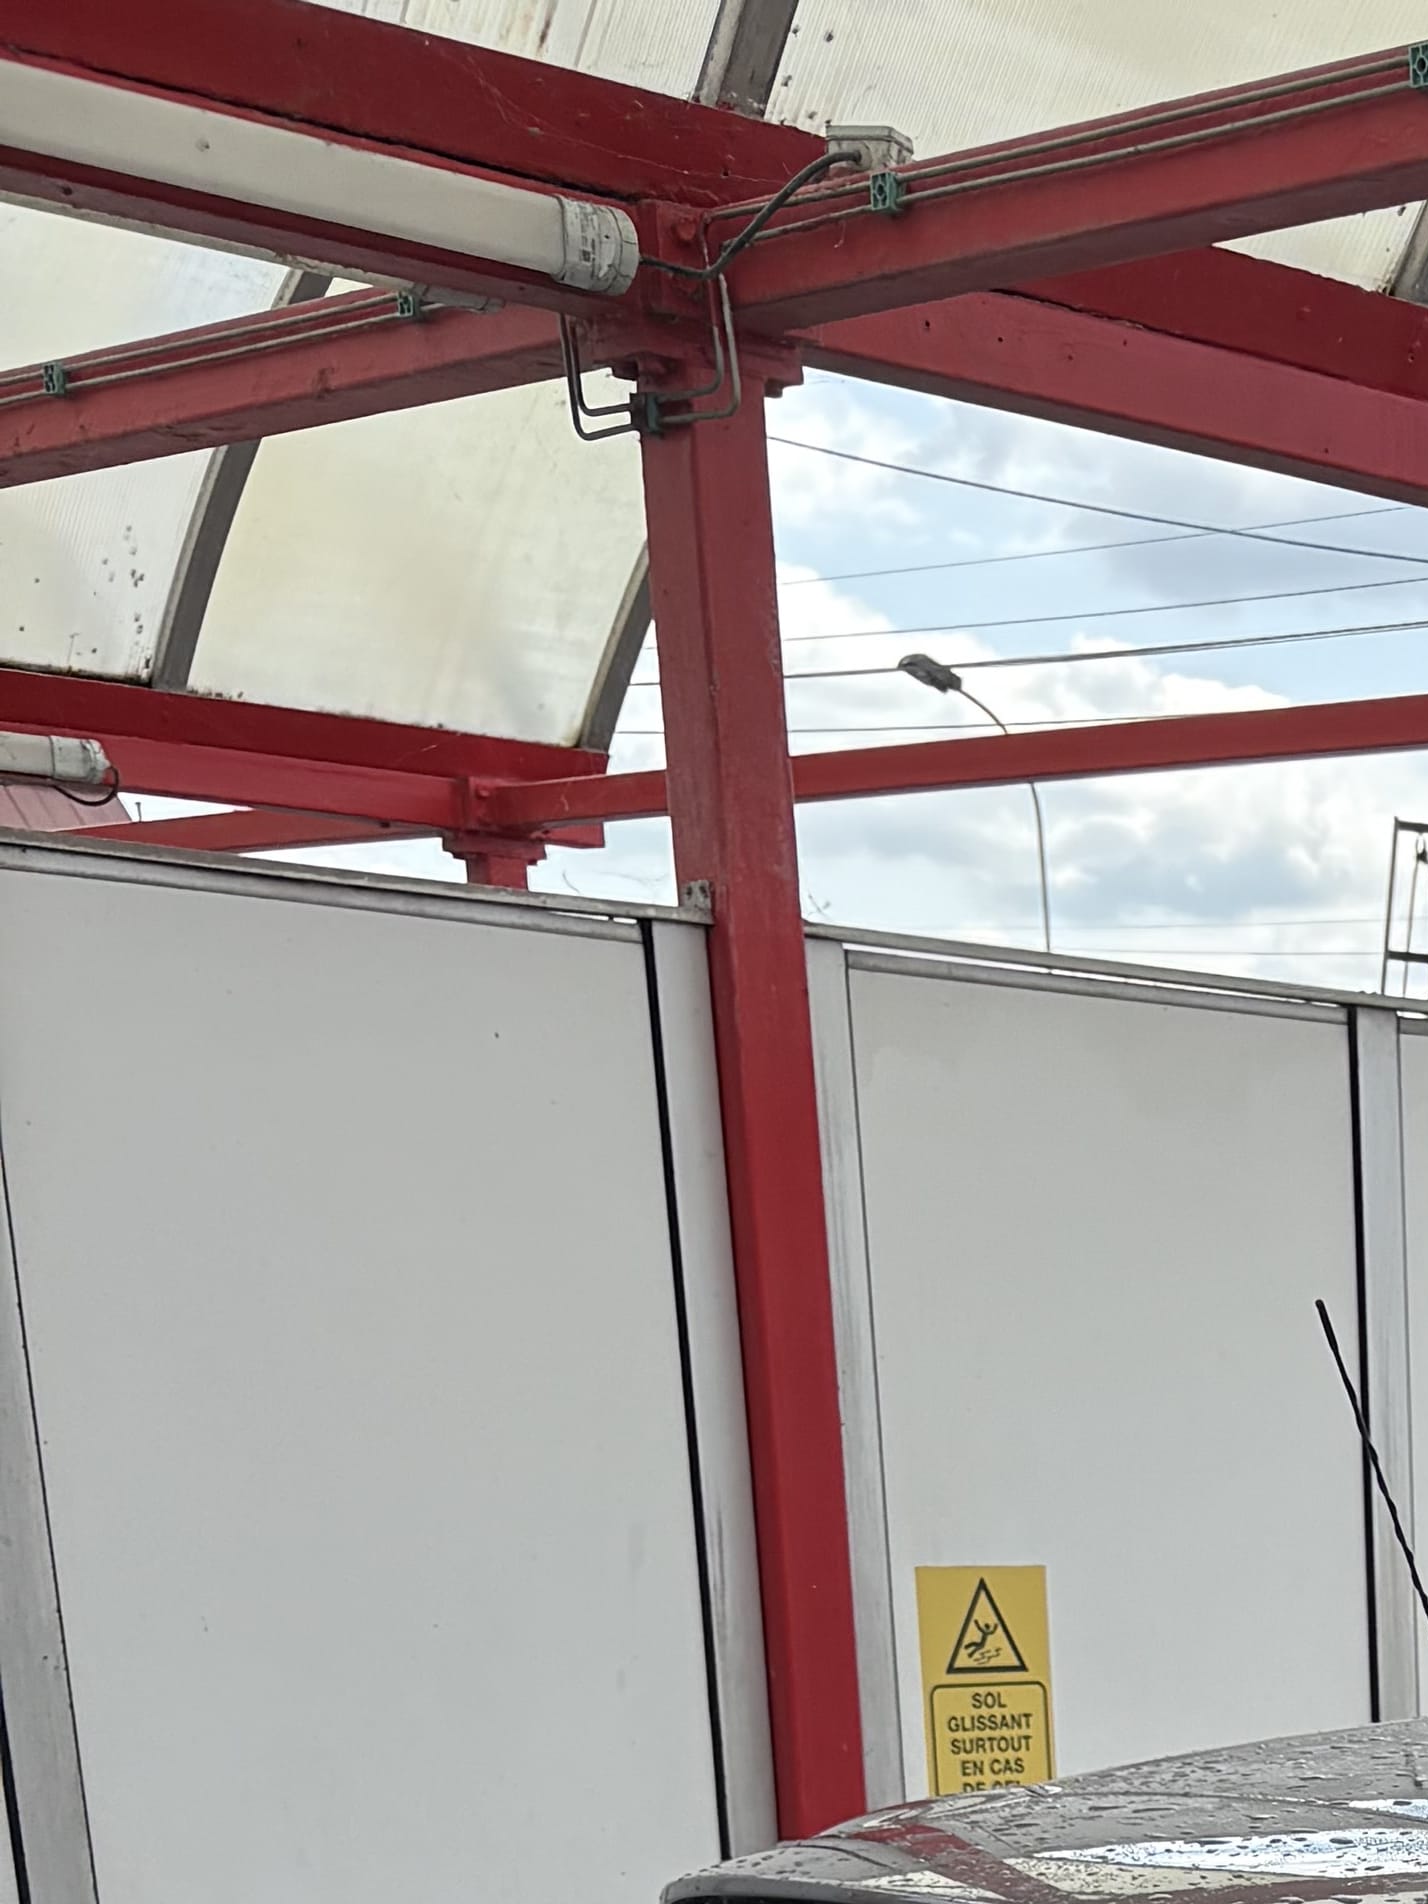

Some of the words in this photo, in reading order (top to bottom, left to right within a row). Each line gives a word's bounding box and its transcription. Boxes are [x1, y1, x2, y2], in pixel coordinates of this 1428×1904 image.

[971, 1691, 1007, 1709] SOL
[947, 1713, 1033, 1733] GLISSANT
[951, 1735, 1033, 1755] SURTOUT
[962, 1760, 985, 1777] EN
[990, 1757, 1025, 1775] CAS
